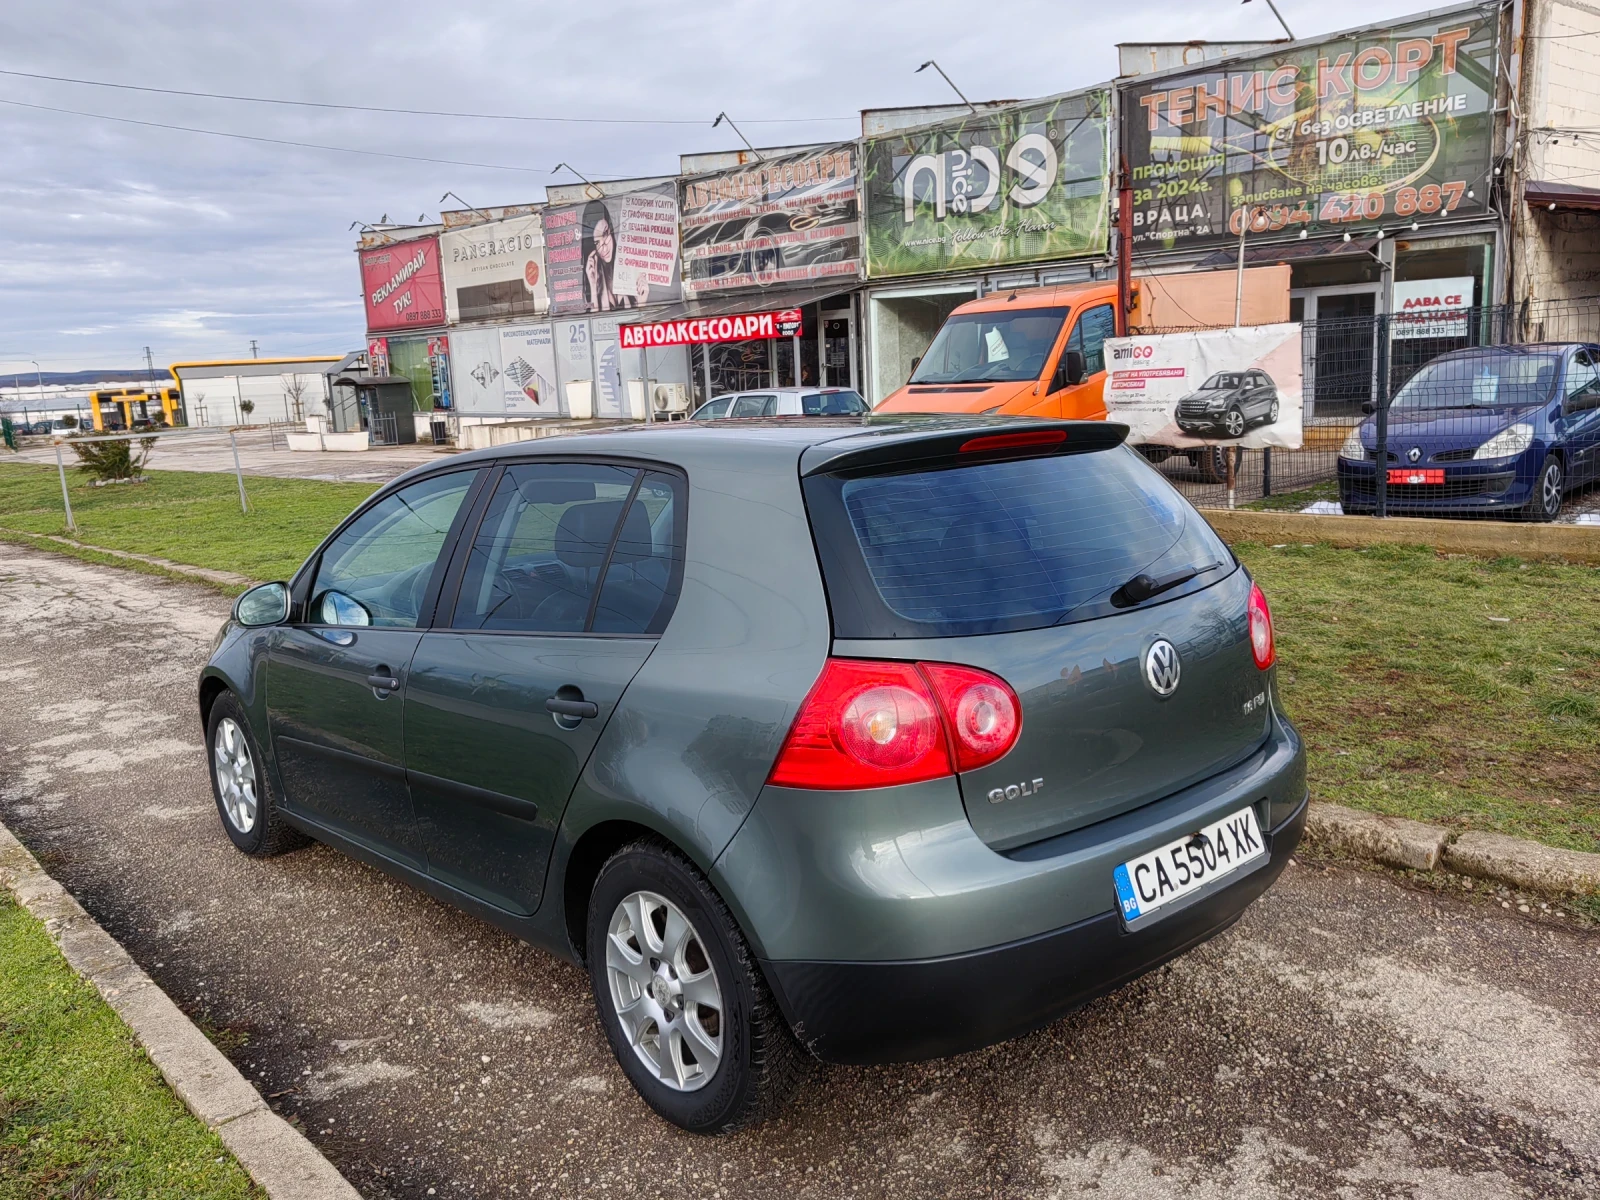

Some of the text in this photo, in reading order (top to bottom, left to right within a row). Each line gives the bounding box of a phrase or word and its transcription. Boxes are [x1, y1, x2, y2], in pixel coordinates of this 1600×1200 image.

[1140, 27, 1470, 132] ТЕНИС КОРТ
[1300, 118, 1331, 136] без
[1335, 93, 1467, 130] ОСВЕТЛЕНИЕ
[1133, 153, 1225, 180] ПРОМОЦИЯ
[683, 151, 851, 211] АВТОАКСЕСОАРИ
[1133, 177, 1213, 206] за 2024г.
[1232, 187, 1303, 208] записване
[1325, 175, 1383, 192] часове:
[655, 200, 674, 209] УСЛУГИ
[1229, 180, 1467, 236] 0894 420 887
[627, 209, 675, 223] ГРАФИЧЕН ДИЗАЙН
[1133, 203, 1211, 227] ВРАЦА,
[628, 222, 674, 236] ПЕЧАТНА РЕКЛАМА
[810, 226, 845, 240] КСЕНОНИ
[950, 218, 1057, 246] Follow the Flavor
[452, 234, 533, 263] PANCRACIO
[648, 237, 672, 248] РЕКЛАМА
[904, 235, 947, 247] www.nice.bg
[623, 245, 649, 257] РЕКЛАМНИ
[471, 260, 515, 273] ARTISAN CHOCOLATE
[624, 257, 669, 272] ФИРМЕНИ ПЕЧАТИ
[371, 248, 426, 307] РЕКЛАМИРАЙ
[647, 273, 670, 284] ТЕНИСКИ
[393, 289, 412, 315] ТУК!
[1403, 294, 1463, 309] ДАВА СЕ
[431, 308, 442, 319] 333
[569, 323, 587, 344] 25
[623, 314, 773, 346] АВТОАКСЕСОАРИ
[1396, 328, 1414, 336] 0897
[1416, 327, 1431, 335] 888
[526, 338, 552, 346] МАТЕРИАЛИ
[1139, 369, 1184, 378] УПОТРЕБЯВАНИ
[988, 777, 1044, 804] GOLF
[1123, 896, 1137, 913] BG
